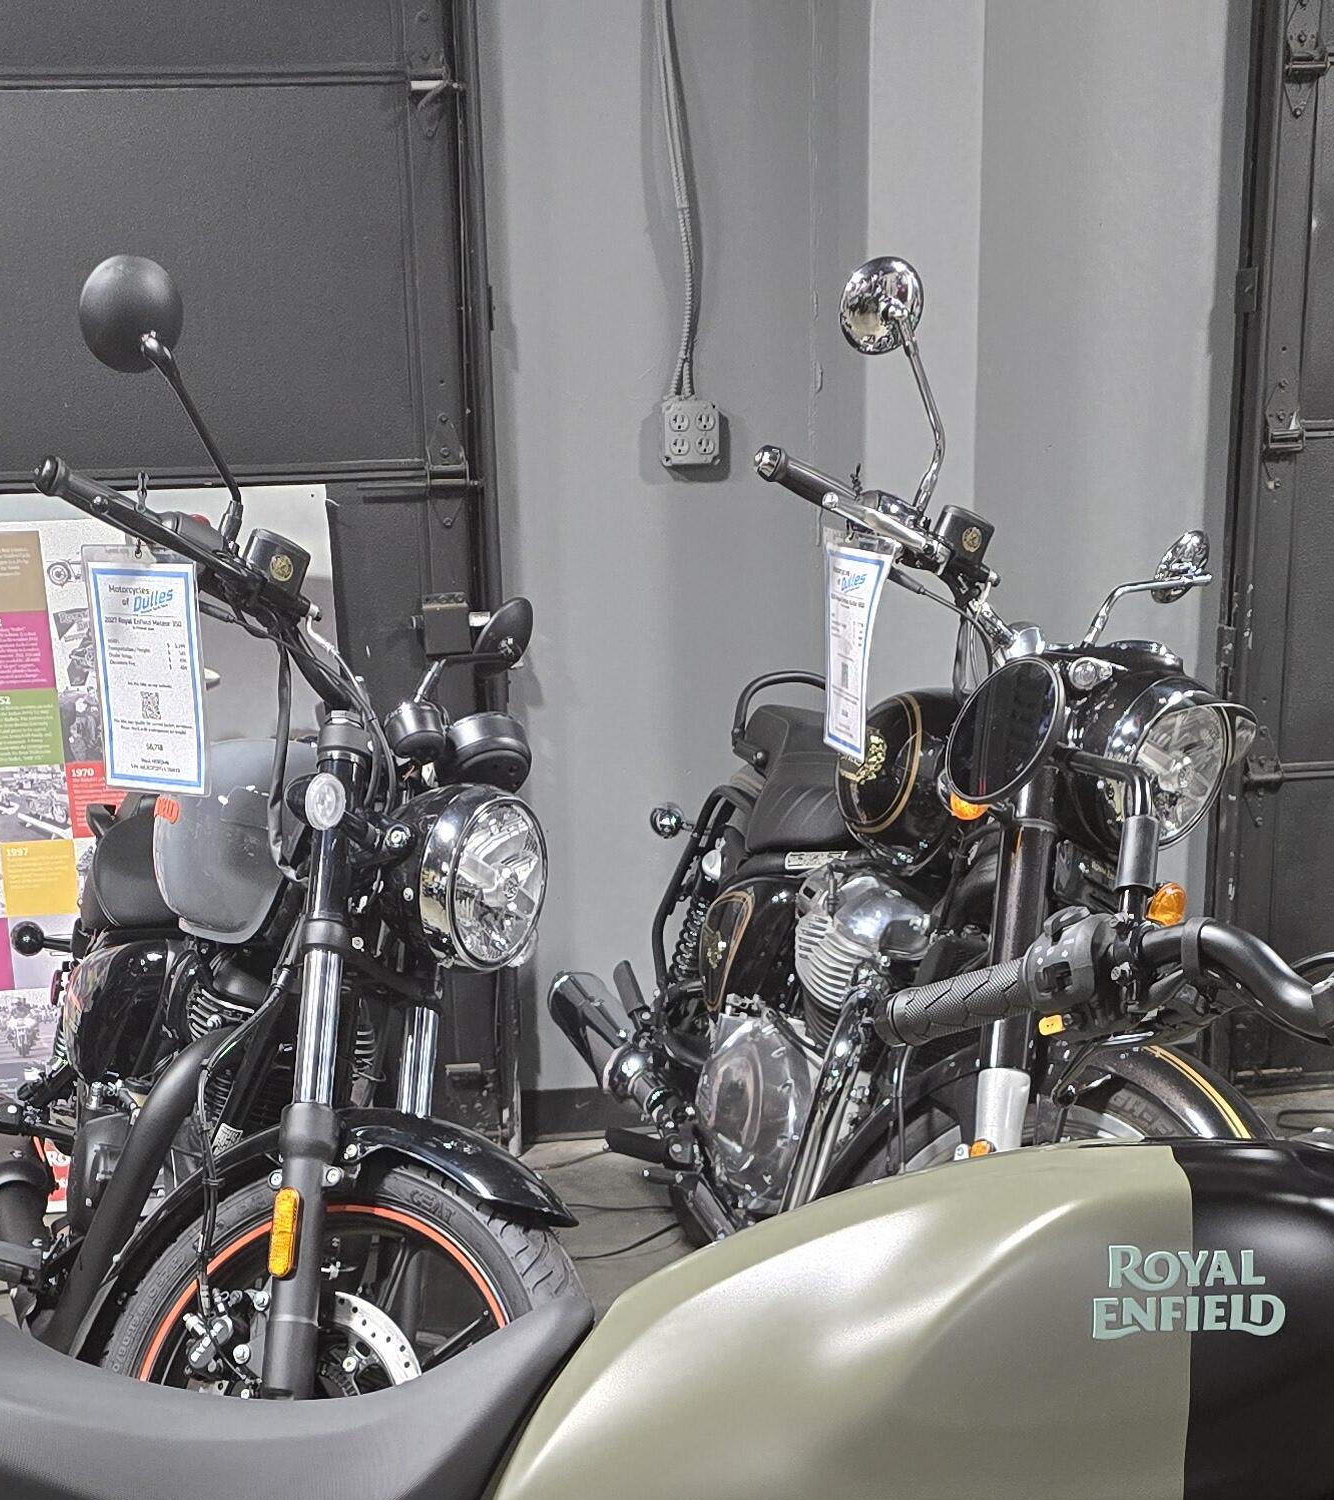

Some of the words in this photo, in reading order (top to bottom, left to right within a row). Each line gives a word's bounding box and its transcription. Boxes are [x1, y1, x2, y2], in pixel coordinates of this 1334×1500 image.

[108, 584, 149, 595] Motorcycles
[122, 598, 129, 606] of
[134, 589, 173, 612] Dulles
[71, 768, 94, 777] 1970
[409, 1189, 456, 1224] CEAT
[1108, 1244, 1266, 1292] ROYAL
[1092, 1294, 1286, 1339] ENFIELD
